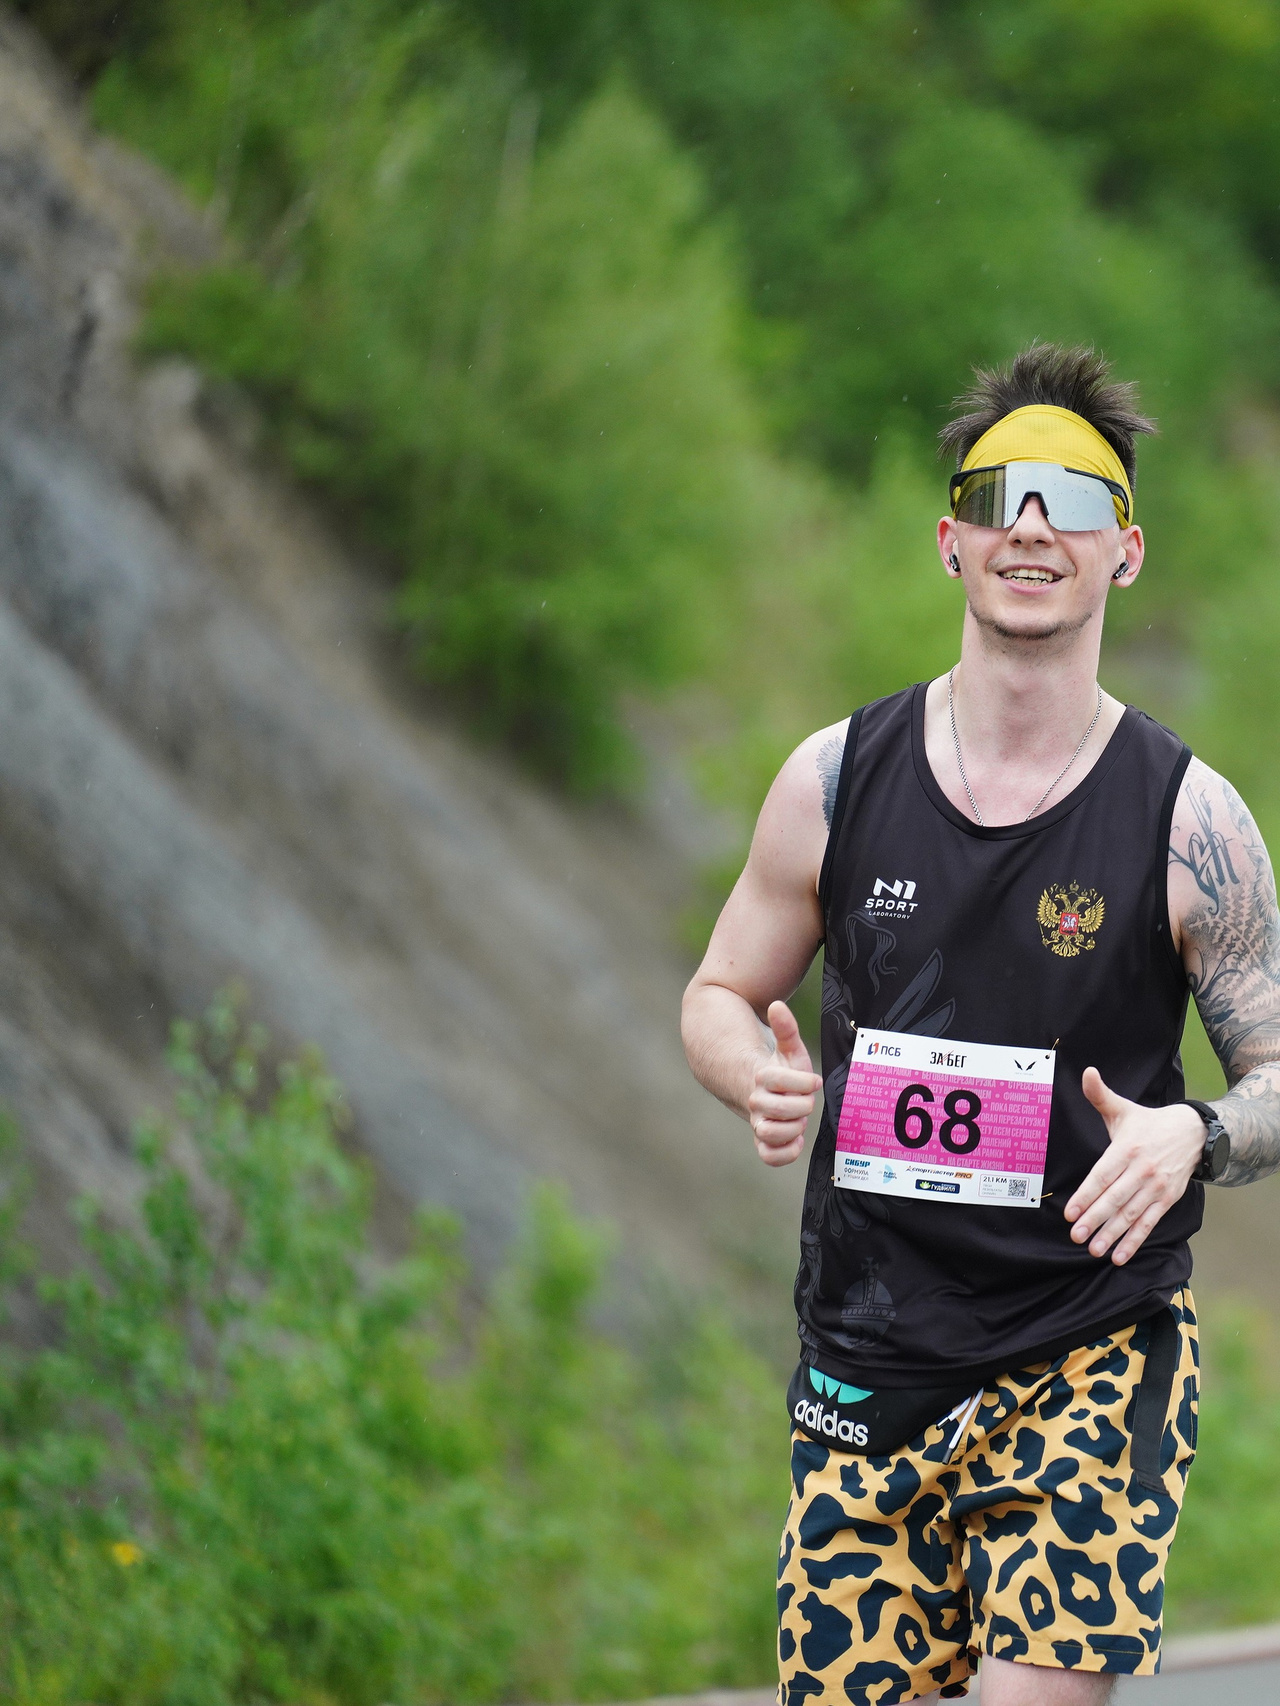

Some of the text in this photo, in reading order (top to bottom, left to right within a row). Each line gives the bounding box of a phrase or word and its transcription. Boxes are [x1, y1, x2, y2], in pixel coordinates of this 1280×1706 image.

[874, 879, 916, 898] N1
[865, 899, 918, 912] SPORT
[869, 911, 911, 919] LABORATORY
[881, 1046, 901, 1057] ПСБ
[1008, 1081, 1032, 1091] СТРЕСС
[1003, 1091, 1029, 1102] ФИНИШ
[991, 1102, 1008, 1112] ПОКА
[1009, 1103, 1021, 1113] ВСЕ
[1022, 1105, 1038, 1115] СПЯТ
[894, 1084, 982, 1155] 68
[999, 1114, 1046, 1128] ПЕРЕЗАГРУЗКА
[993, 1126, 1011, 1136] ВСЕМ
[1011, 1127, 1041, 1140] СЕРДЦЕМ
[1021, 1140, 1039, 1151] ПОКА
[982, 1148, 1004, 1159] РАМКИ
[1016, 1151, 1044, 1162] БЕГОВАЯ
[845, 1158, 871, 1168] СИБУР
[1015, 1163, 1031, 1173] БЕГУ
[795, 1399, 868, 1446] adidas
